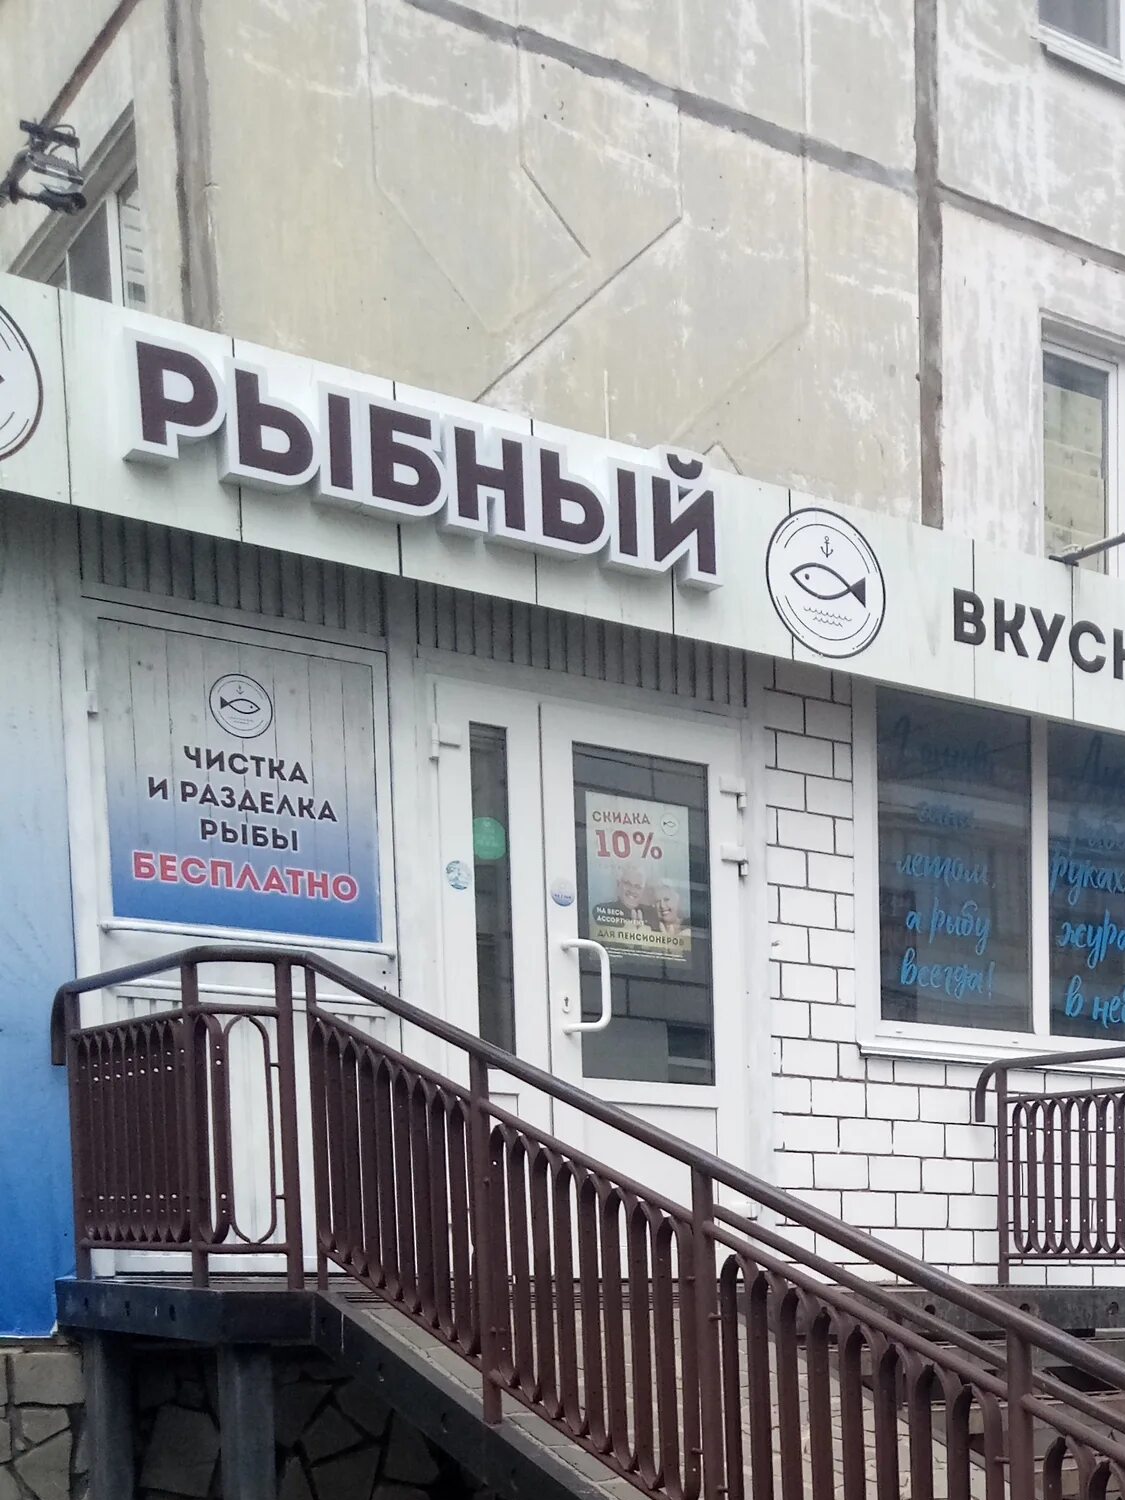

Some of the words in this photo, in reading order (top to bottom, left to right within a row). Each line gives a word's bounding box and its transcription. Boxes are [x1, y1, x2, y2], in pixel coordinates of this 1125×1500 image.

[133, 337, 719, 579] РЫБНЫЙ
[183, 744, 309, 785] ЧИСТКА
[147, 776, 169, 801] И
[180, 779, 338, 823] РАЗДЕЛКА
[592, 810, 651, 826] СКИДКА
[200, 818, 299, 852] РЫБЫ
[595, 829, 663, 860] 10%
[132, 850, 359, 902] БЕСПЛАТНО
[929, 900, 991, 955] рыбу
[1064, 975, 1085, 1018] в
